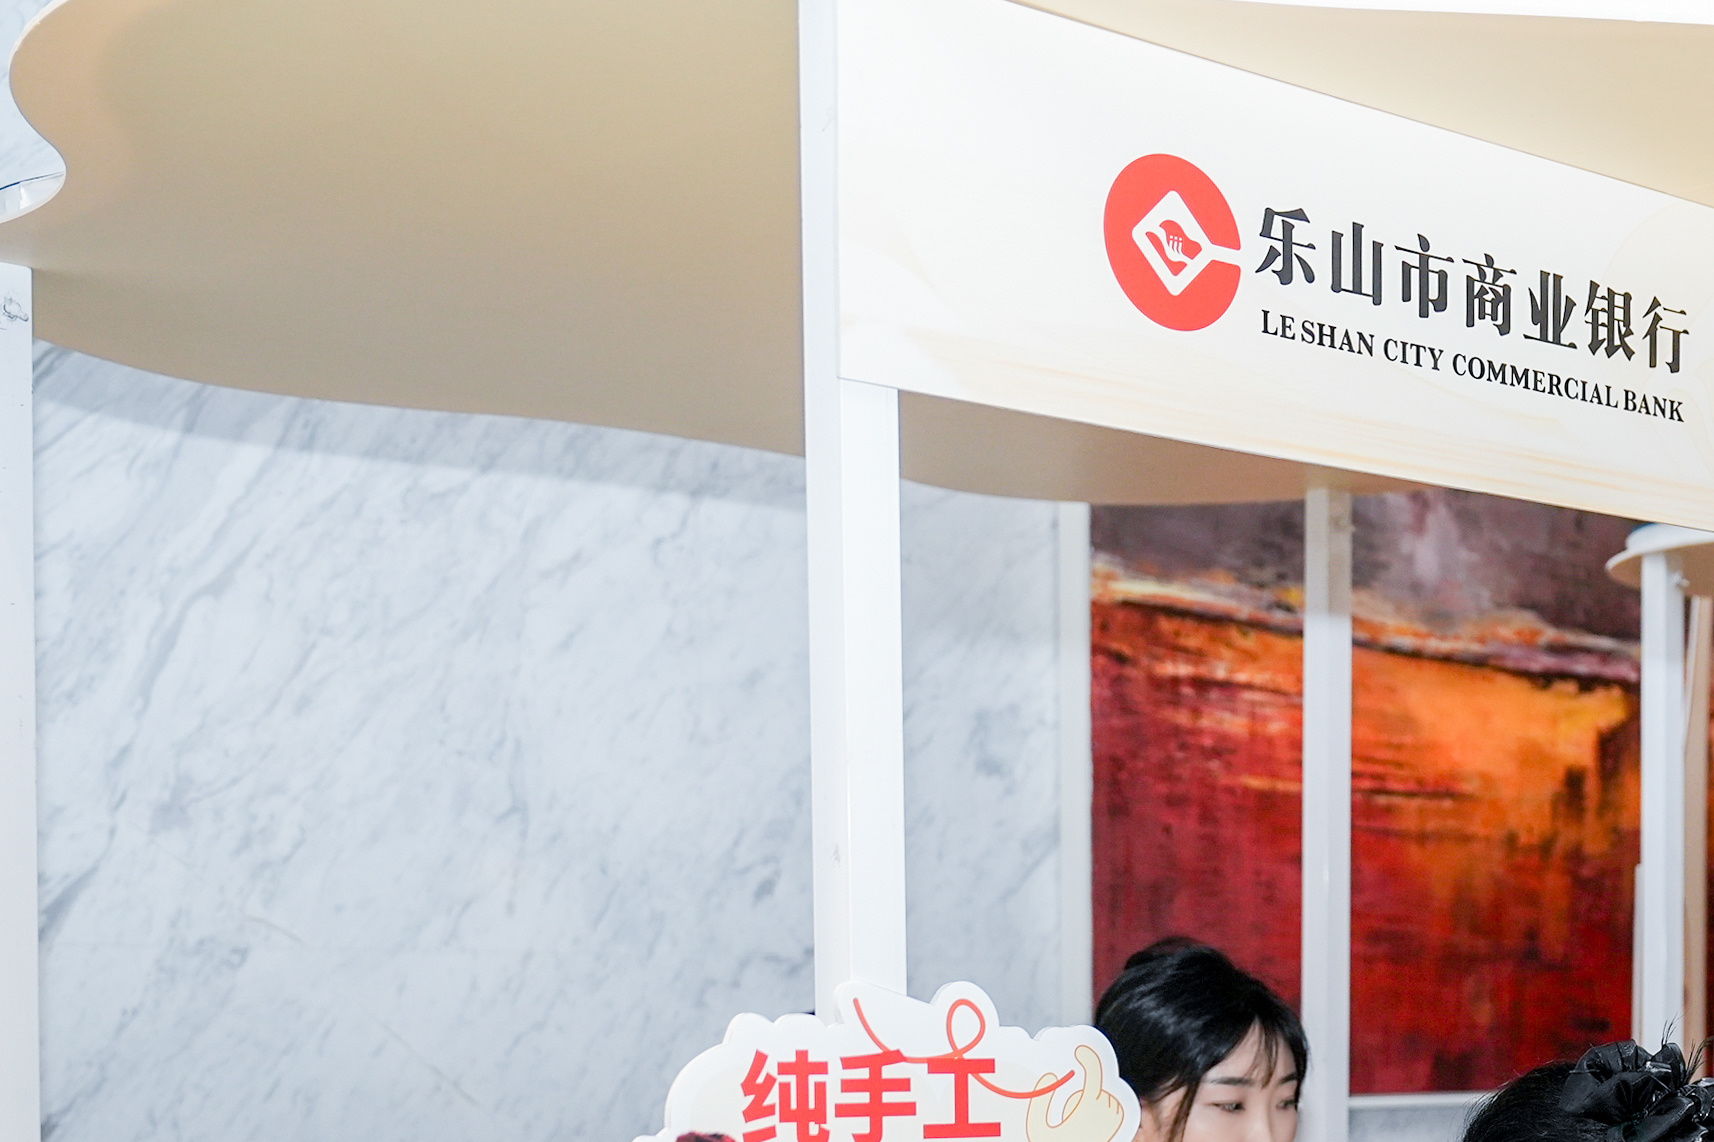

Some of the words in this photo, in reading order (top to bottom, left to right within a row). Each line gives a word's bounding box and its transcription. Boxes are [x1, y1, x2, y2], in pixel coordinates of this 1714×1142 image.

[1255, 207, 1690, 374] 乐山市商业银行
[1261, 309, 1297, 339] LE
[1300, 319, 1376, 357] SHAN
[1383, 338, 1445, 372] CITY
[1452, 353, 1619, 409] COMMERCIAL
[1622, 390, 1686, 423] BANK
